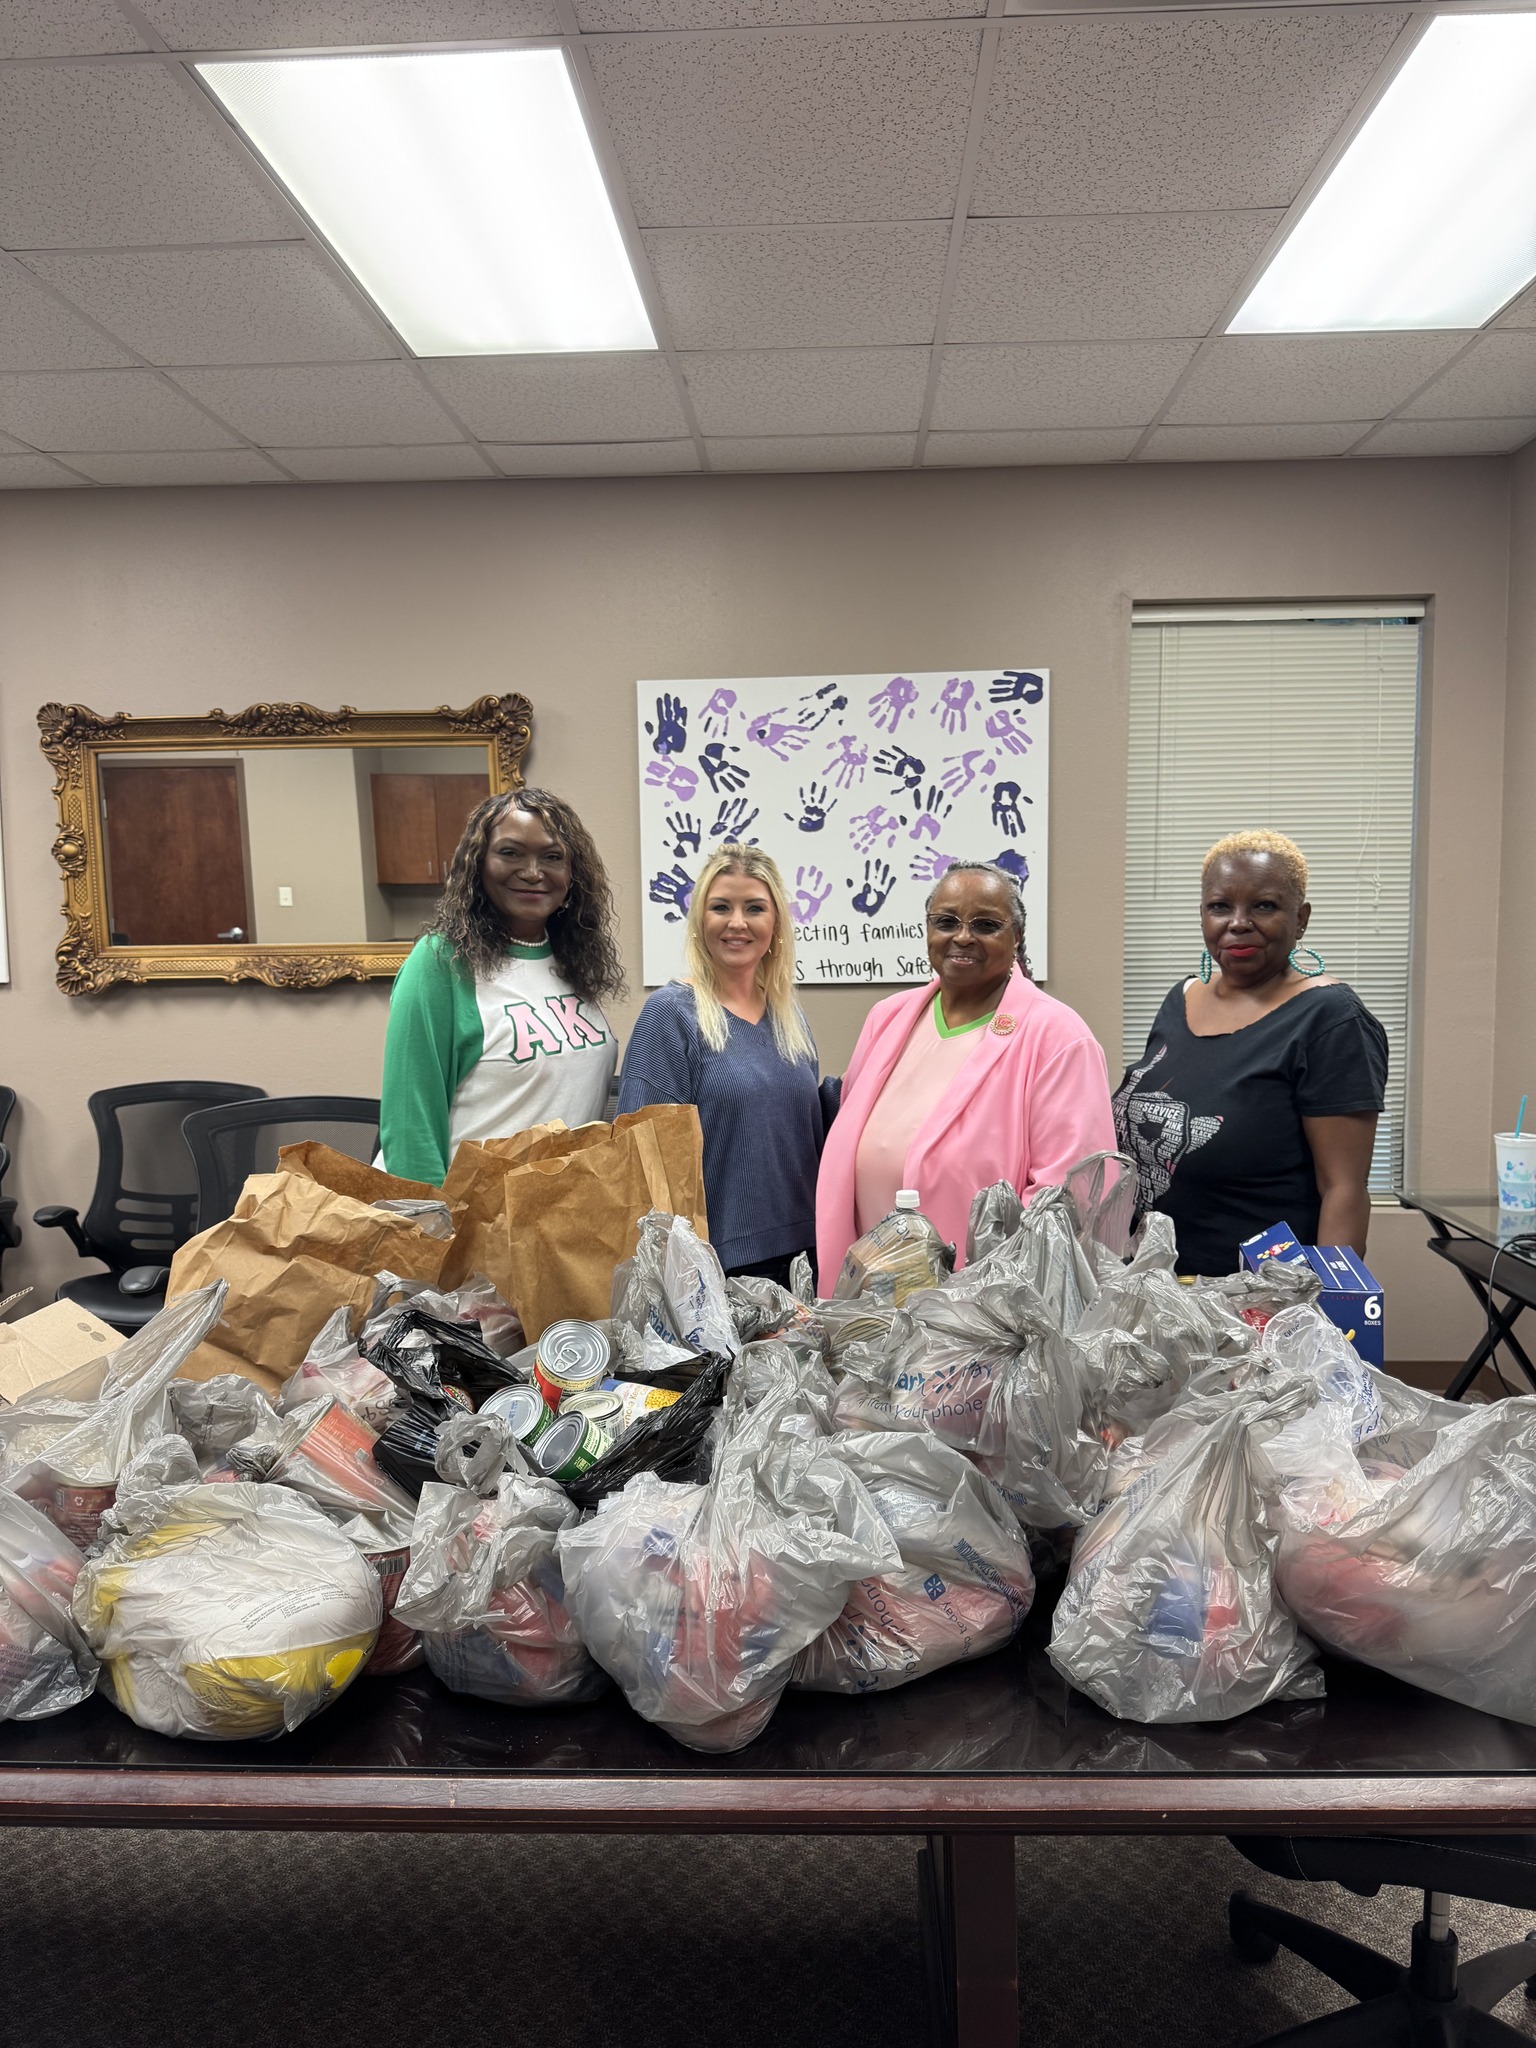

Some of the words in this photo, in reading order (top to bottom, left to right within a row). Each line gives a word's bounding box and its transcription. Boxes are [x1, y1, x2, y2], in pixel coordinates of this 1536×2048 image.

[860, 922, 924, 943] families
[816, 957, 883, 982] through
[896, 955, 931, 977] Safe
[1142, 1102, 1180, 1119] SERVICE
[1164, 1120, 1183, 1132] PINK
[1191, 1129, 1212, 1139] BLACK
[1364, 1295, 1381, 1320] 6
[894, 1404, 929, 1420] your
[931, 1398, 983, 1423] phone
[941, 1601, 968, 1635] today
